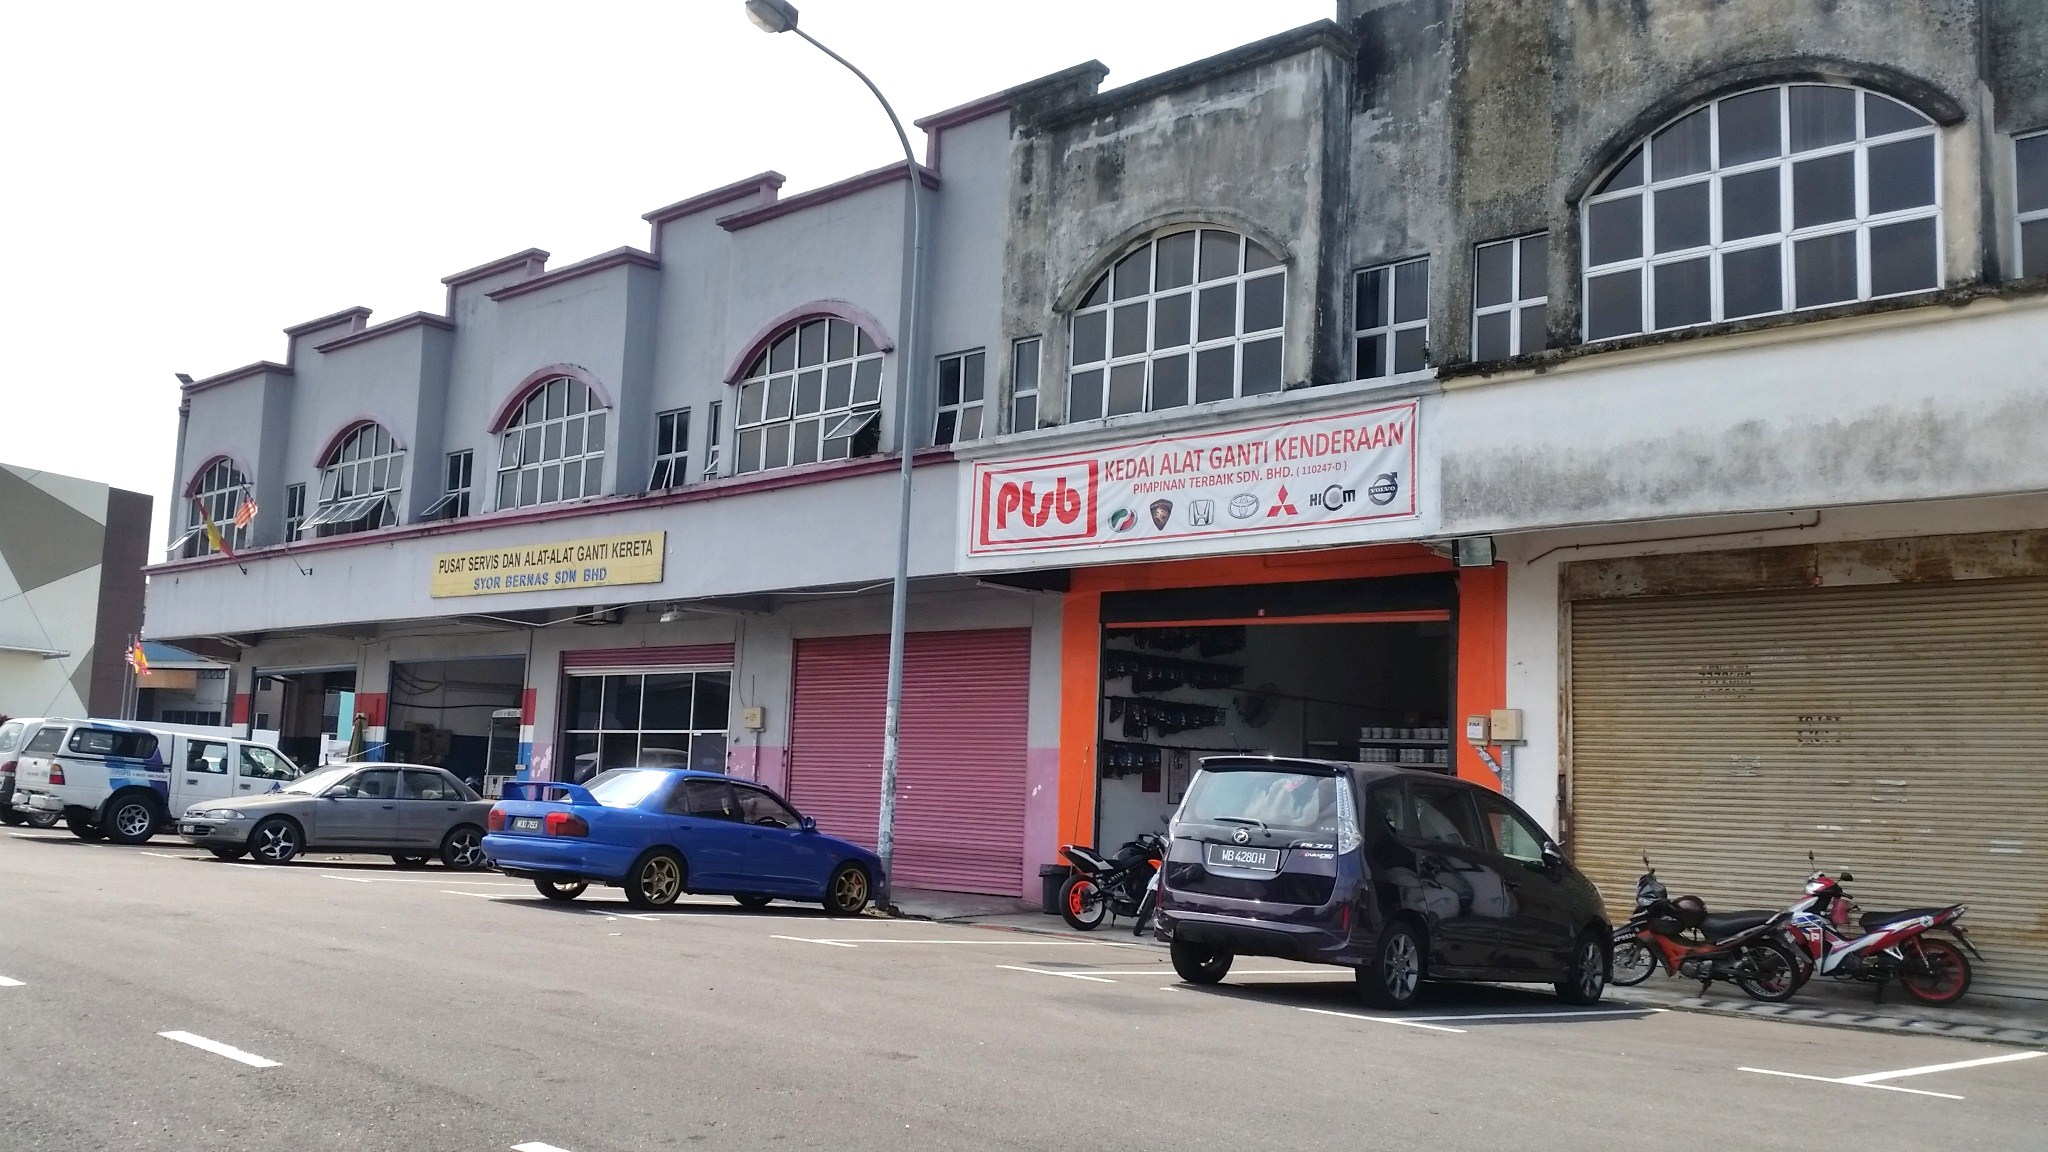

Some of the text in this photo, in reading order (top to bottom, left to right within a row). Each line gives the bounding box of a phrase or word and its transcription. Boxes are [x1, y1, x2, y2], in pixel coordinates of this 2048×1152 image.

[1104, 421, 1403, 482] KEDAI ALAT GANTI KENDERAAN
[1133, 478, 1186, 494] PIMPINAN
[1189, 473, 1234, 489] TERBAIK
[1236, 470, 1263, 484] SDN.
[1266, 466, 1293, 480] BHD.
[438, 539, 653, 574] PUSAT SERVIS DAN ALAT-ALAT GANTI KERETA
[474, 567, 607, 590] SYOR BERNAS SDN BHD
[1222, 849, 1266, 865] WB 4280 H
